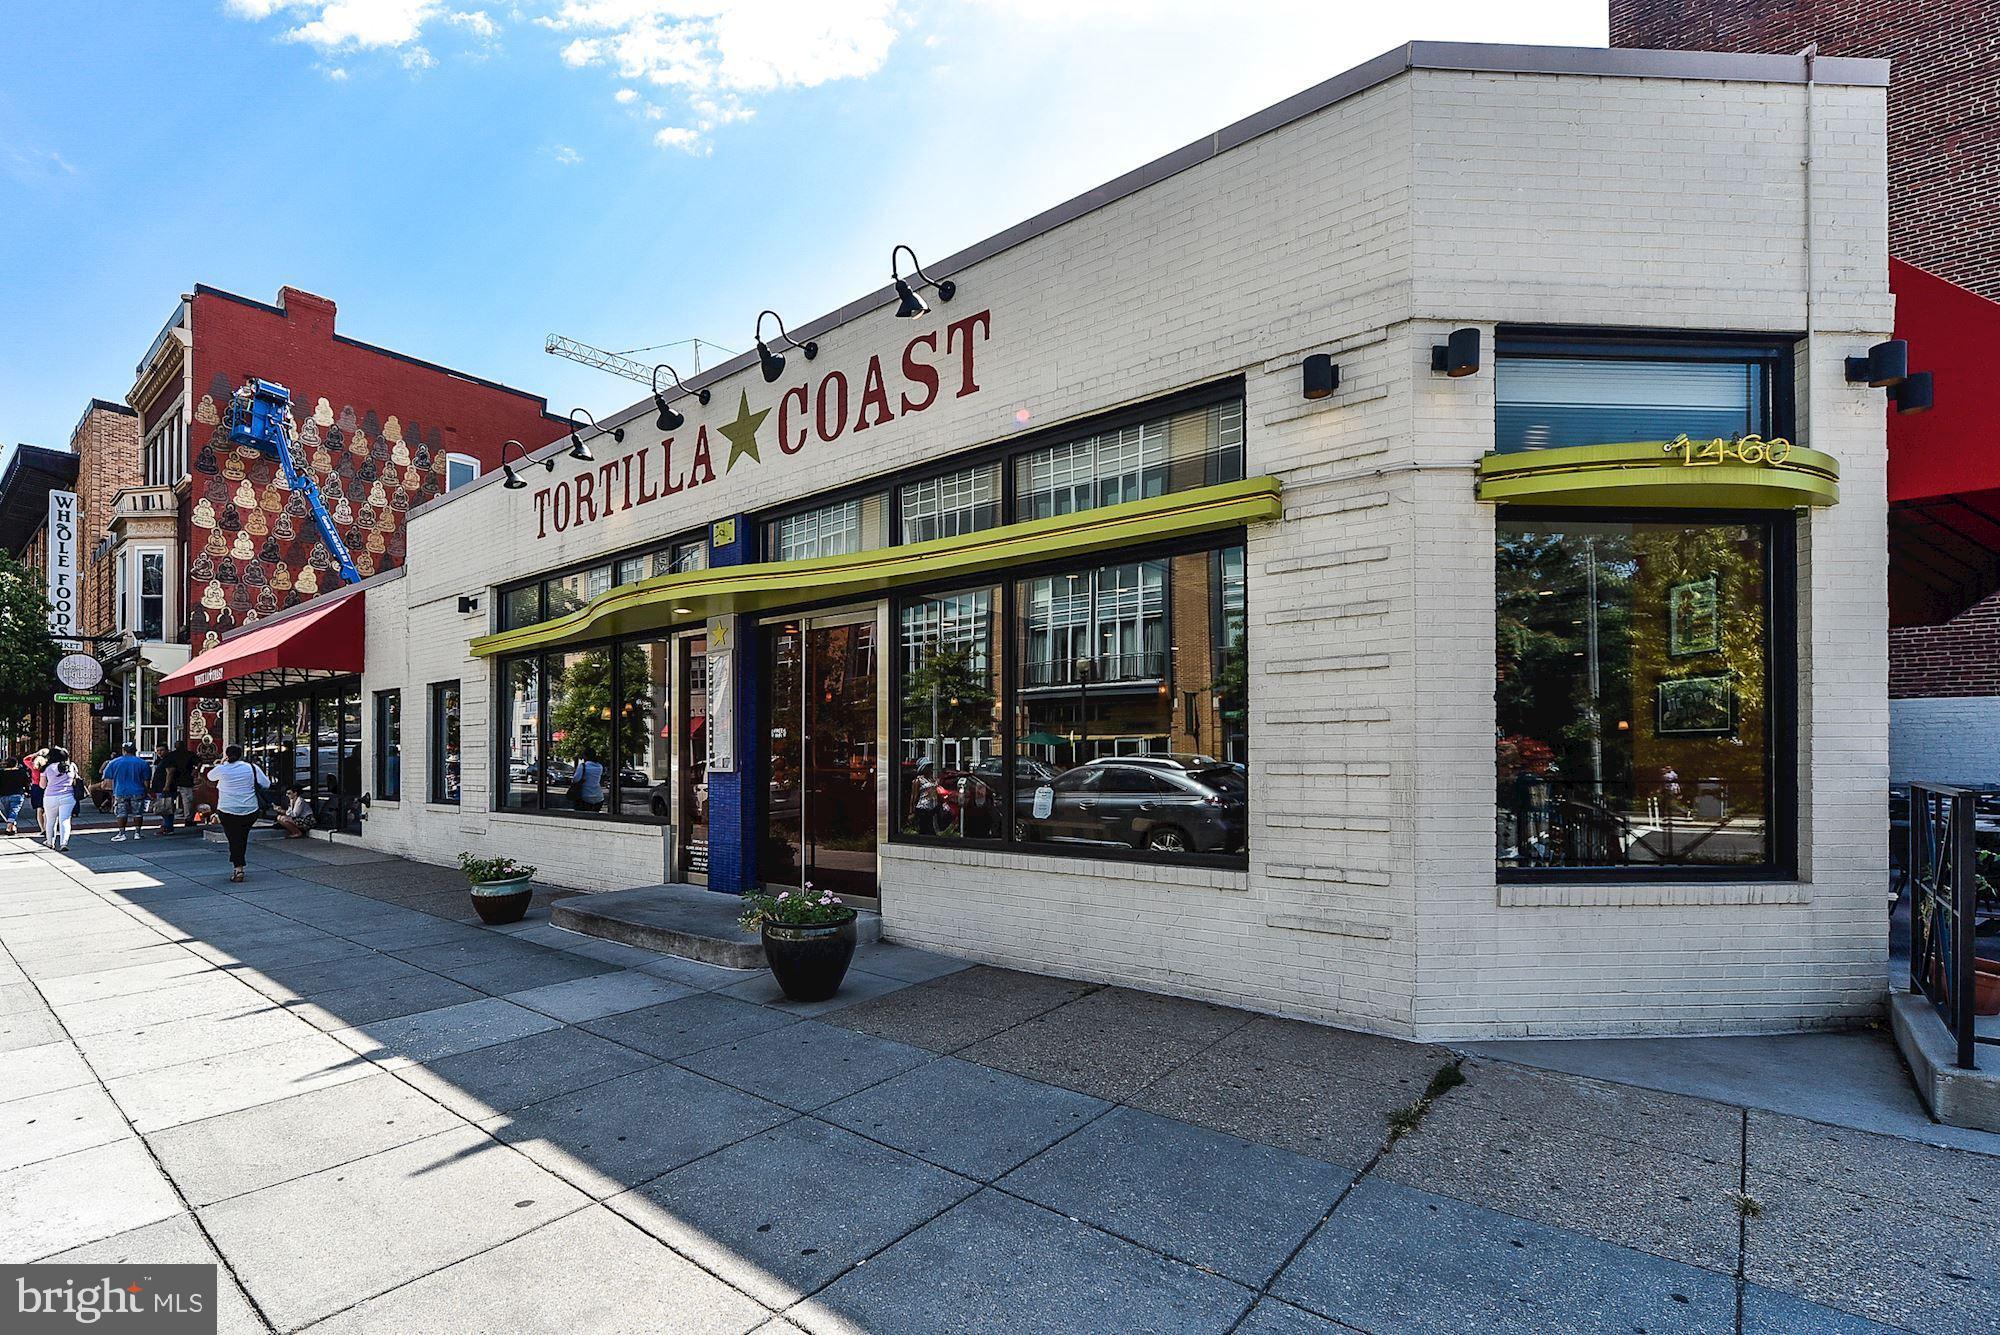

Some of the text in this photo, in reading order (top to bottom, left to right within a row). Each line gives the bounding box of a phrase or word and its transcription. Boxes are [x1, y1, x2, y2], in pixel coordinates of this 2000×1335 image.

[534, 308, 991, 539] TORTILLA COAST
[1671, 433, 1790, 466] 1460
[54, 495, 74, 636] WHOLE FOODS
